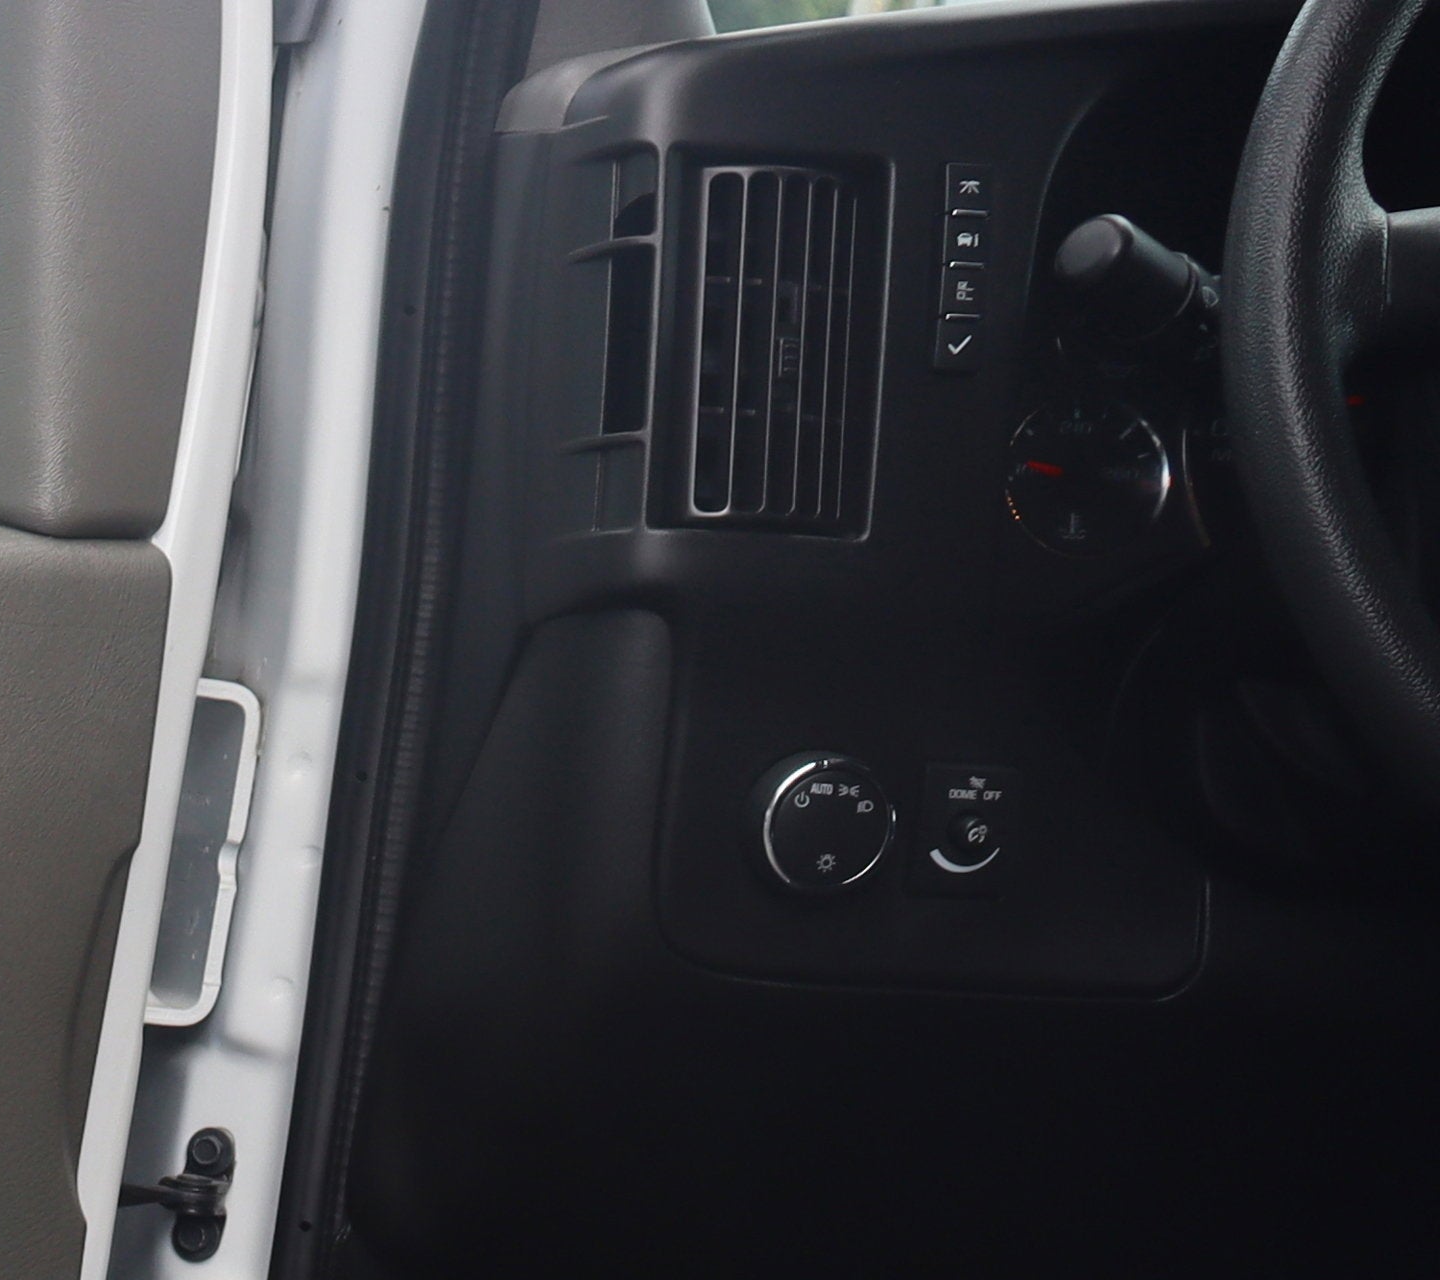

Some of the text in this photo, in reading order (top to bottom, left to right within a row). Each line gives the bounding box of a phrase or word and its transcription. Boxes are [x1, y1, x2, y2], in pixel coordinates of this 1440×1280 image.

[810, 782, 834, 796] AUTO
[948, 788, 1003, 801] DOME OFF
